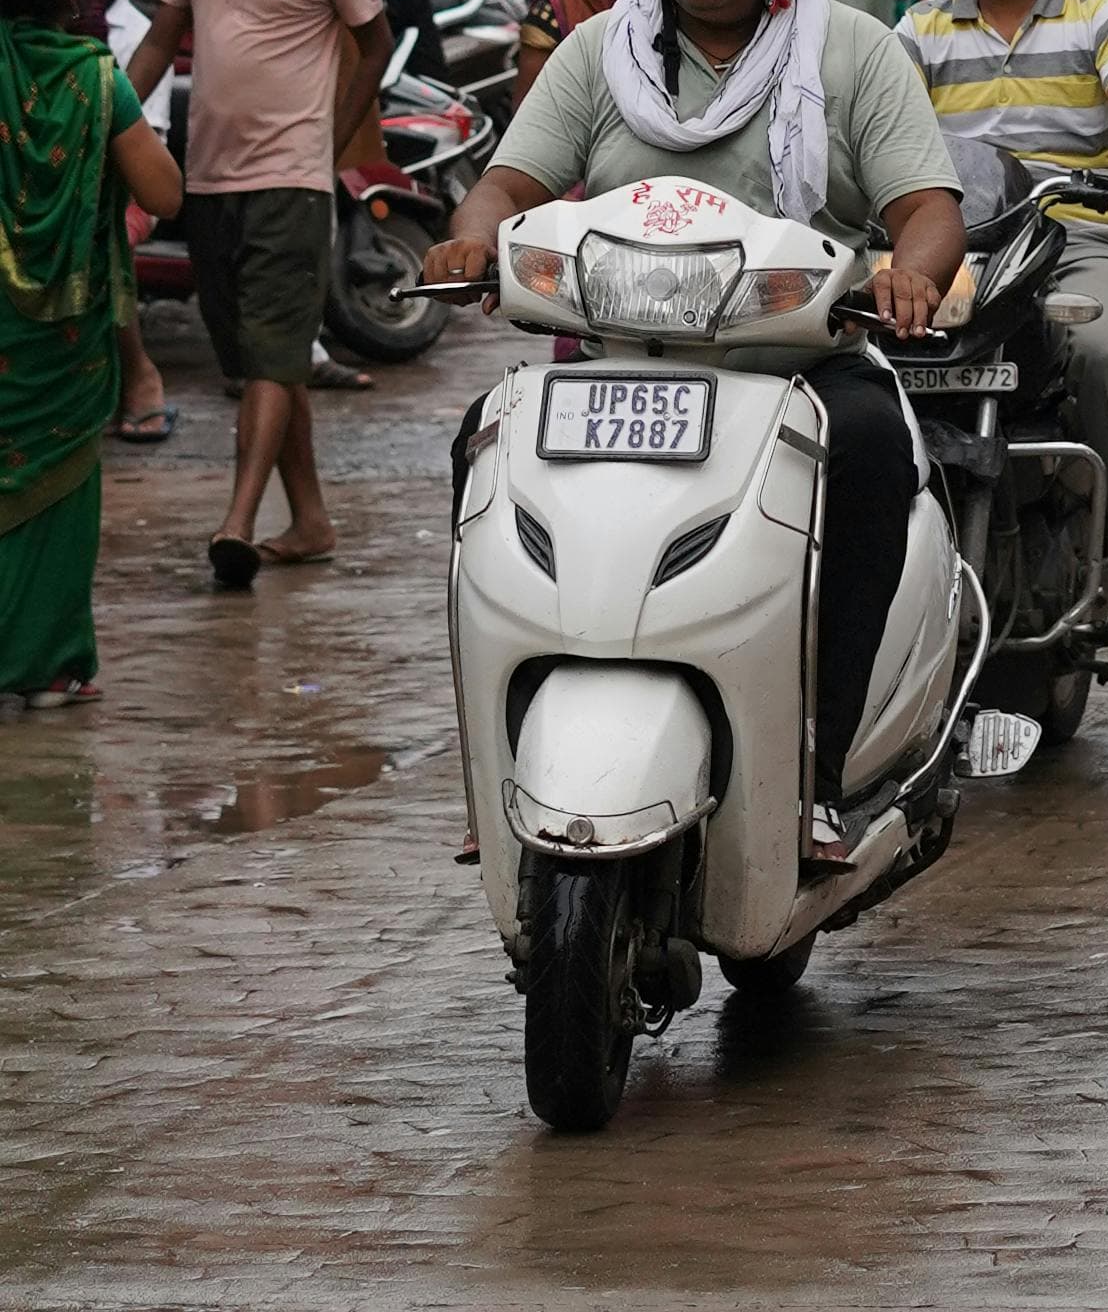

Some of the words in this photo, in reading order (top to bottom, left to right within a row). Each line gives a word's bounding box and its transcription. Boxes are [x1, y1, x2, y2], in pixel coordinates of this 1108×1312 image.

[675, 186, 726, 214] राम
[960, 366, 1012, 387] 6772
[588, 383, 691, 416] UP65C
[556, 411, 575, 421] IND
[585, 418, 689, 449] K7887
